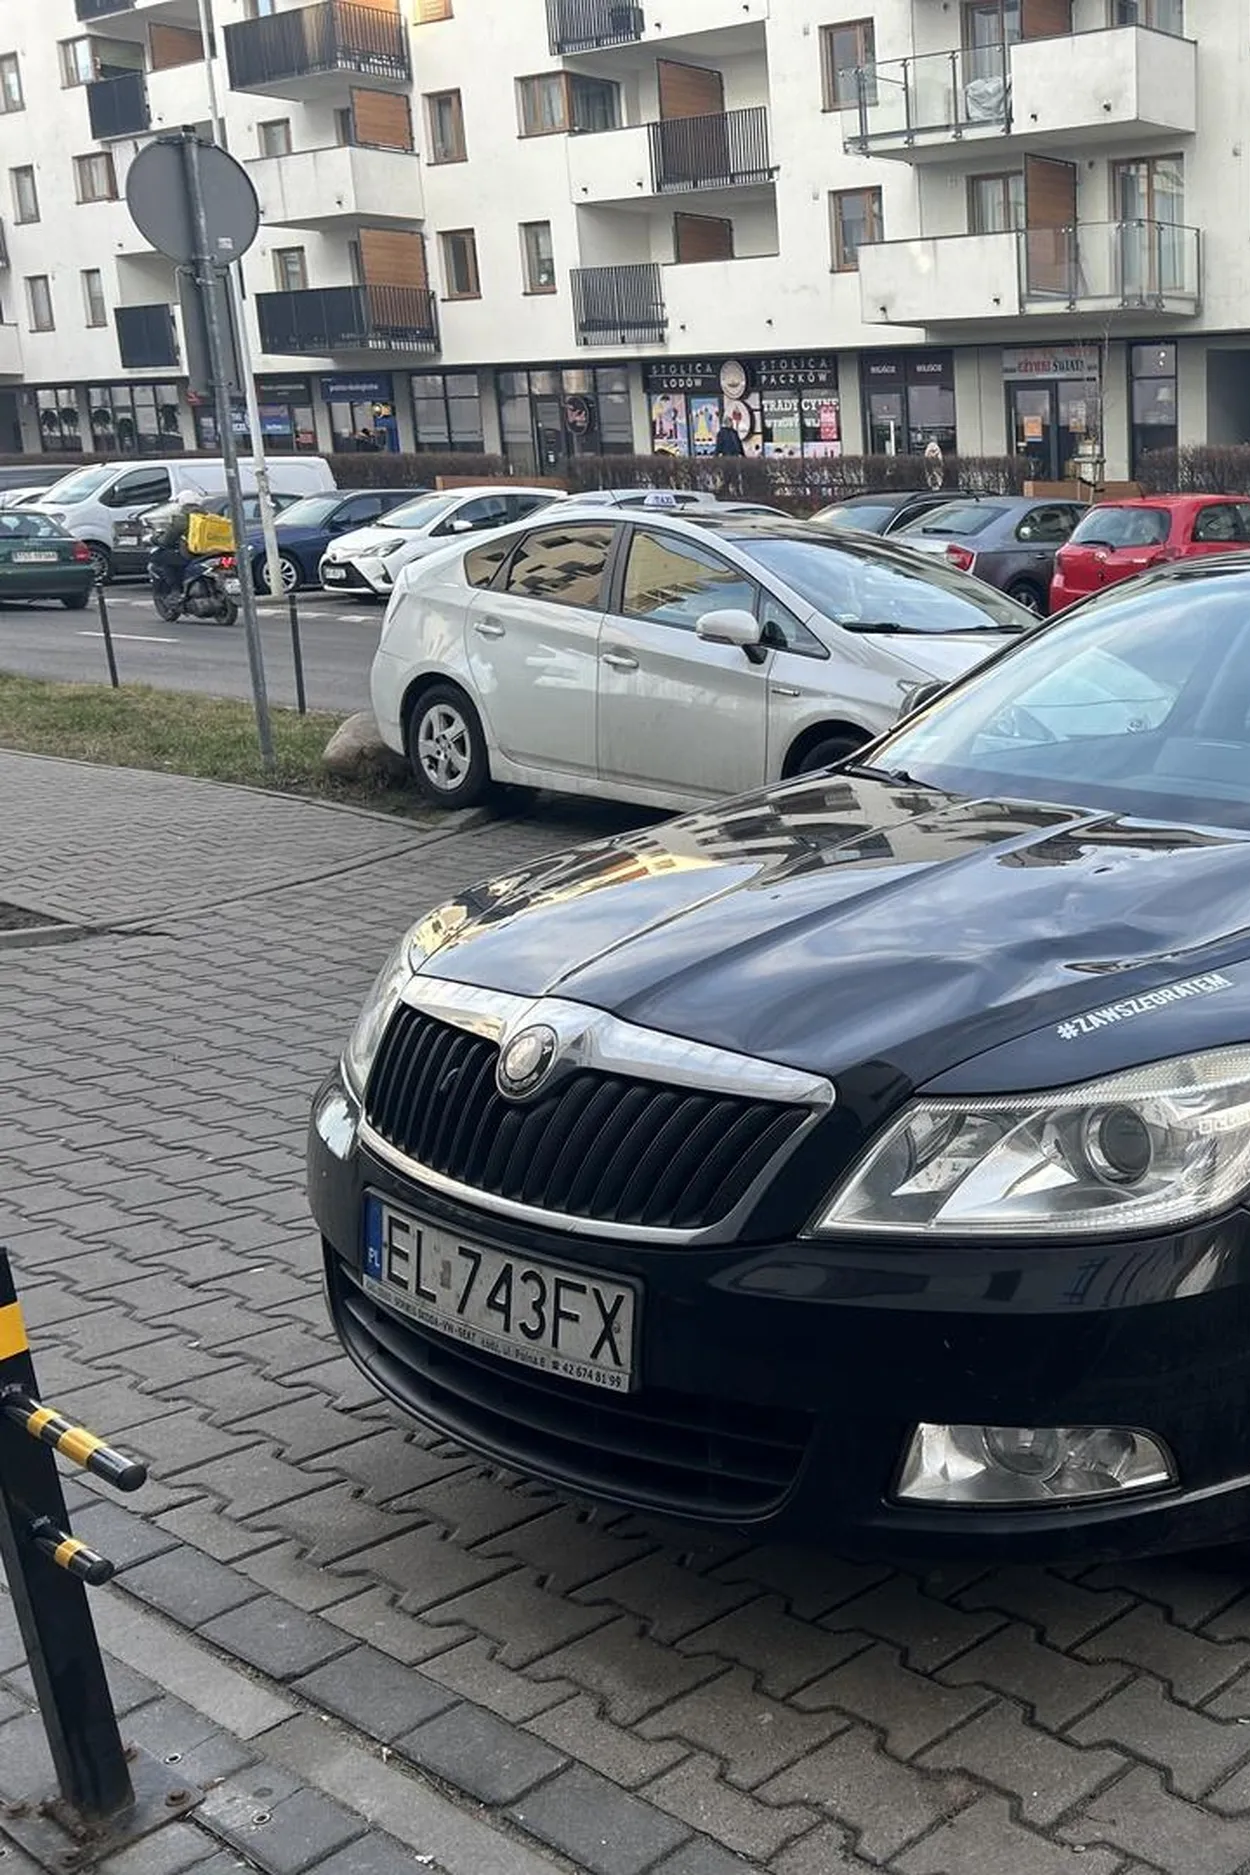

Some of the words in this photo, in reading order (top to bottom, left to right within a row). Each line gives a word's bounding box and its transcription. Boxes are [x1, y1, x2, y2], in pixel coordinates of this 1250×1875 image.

[652, 362, 713, 374] STOLICA
[761, 357, 828, 370] STOLICA
[1056, 972, 1234, 1040] #ZAWSZEGRATEM
[368, 1246, 381, 1268] PL
[457, 1245, 625, 1368] 743FX
[562, 1362, 574, 1376] 42
[576, 1365, 593, 1381] 674
[595, 1371, 607, 1385] 81
[609, 1374, 621, 1388] 99
